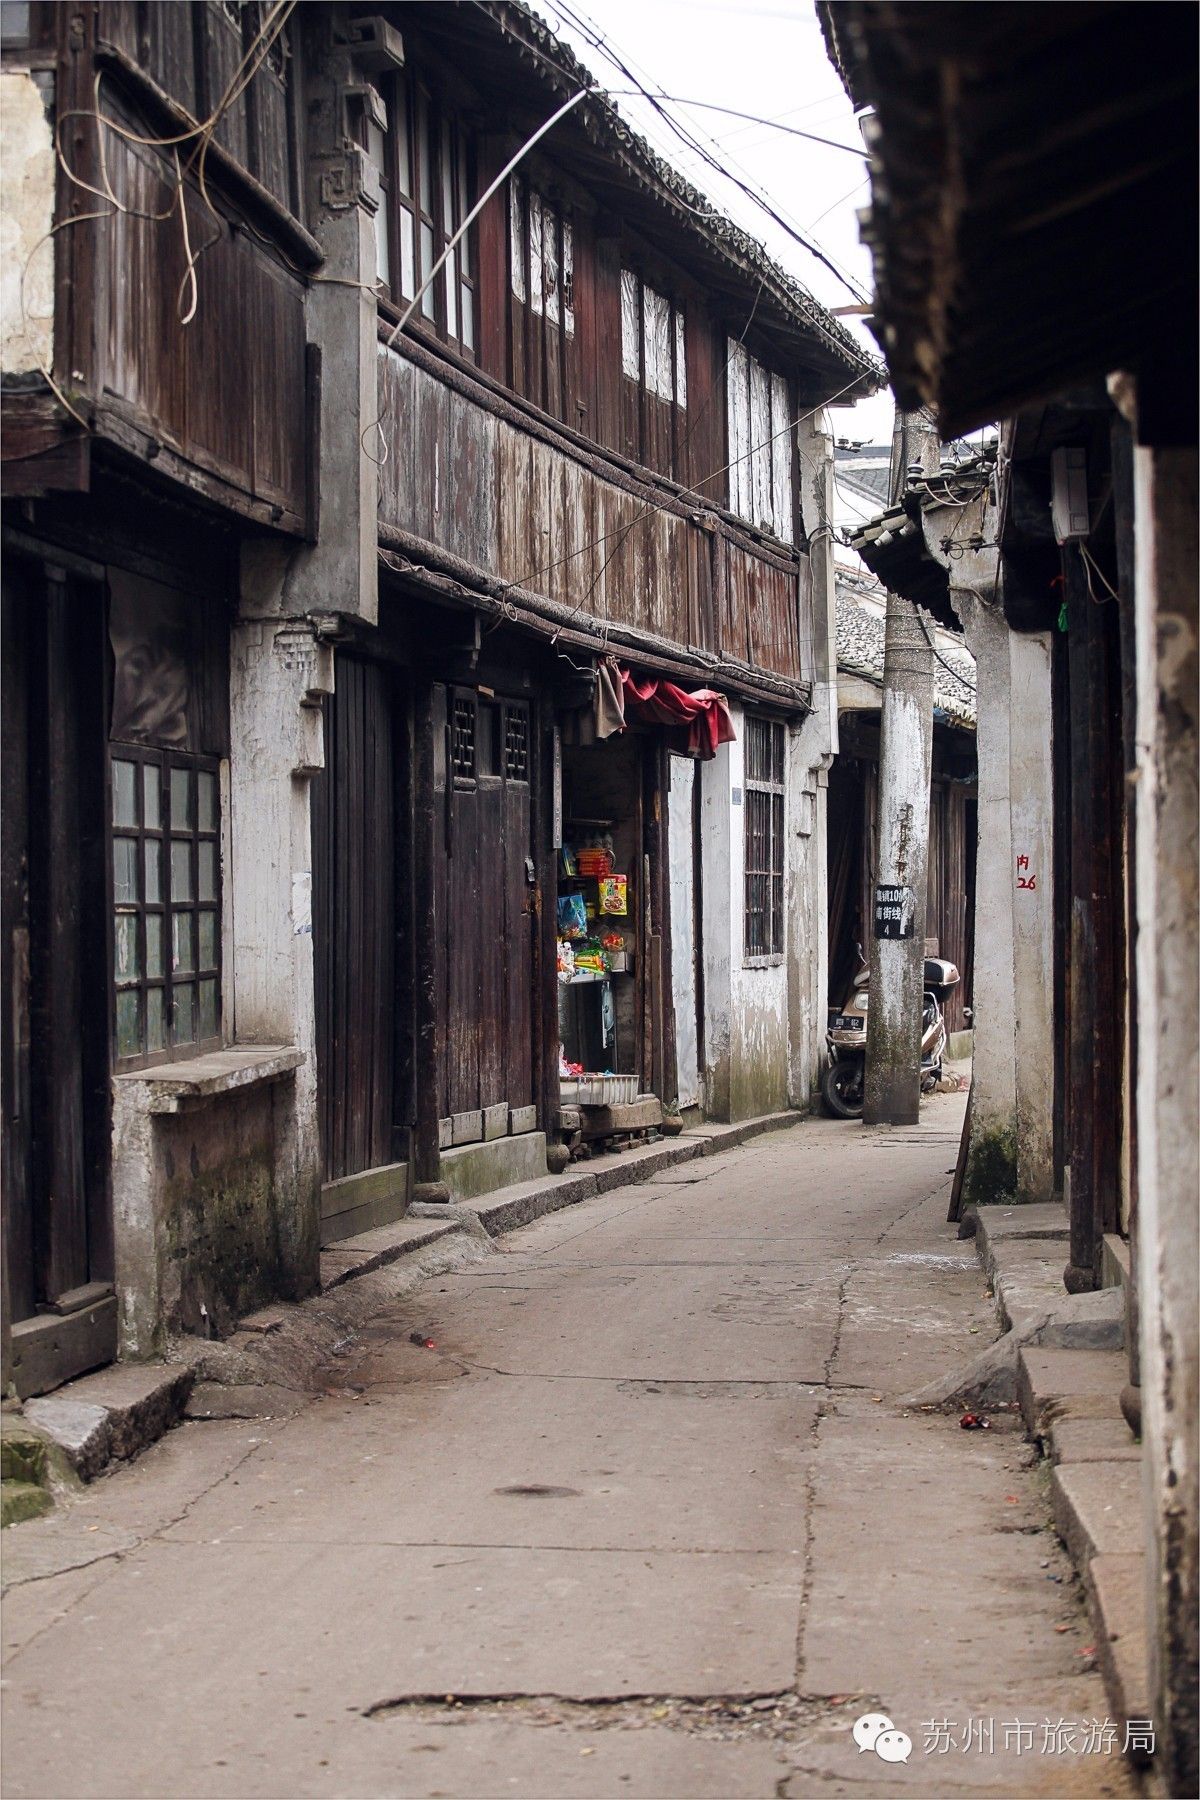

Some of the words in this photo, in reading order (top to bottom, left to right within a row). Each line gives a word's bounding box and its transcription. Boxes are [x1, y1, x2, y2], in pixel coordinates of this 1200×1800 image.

[1016, 854, 1029, 874] 内
[1016, 874, 1036, 890] 26
[884, 924, 890, 935] 4
